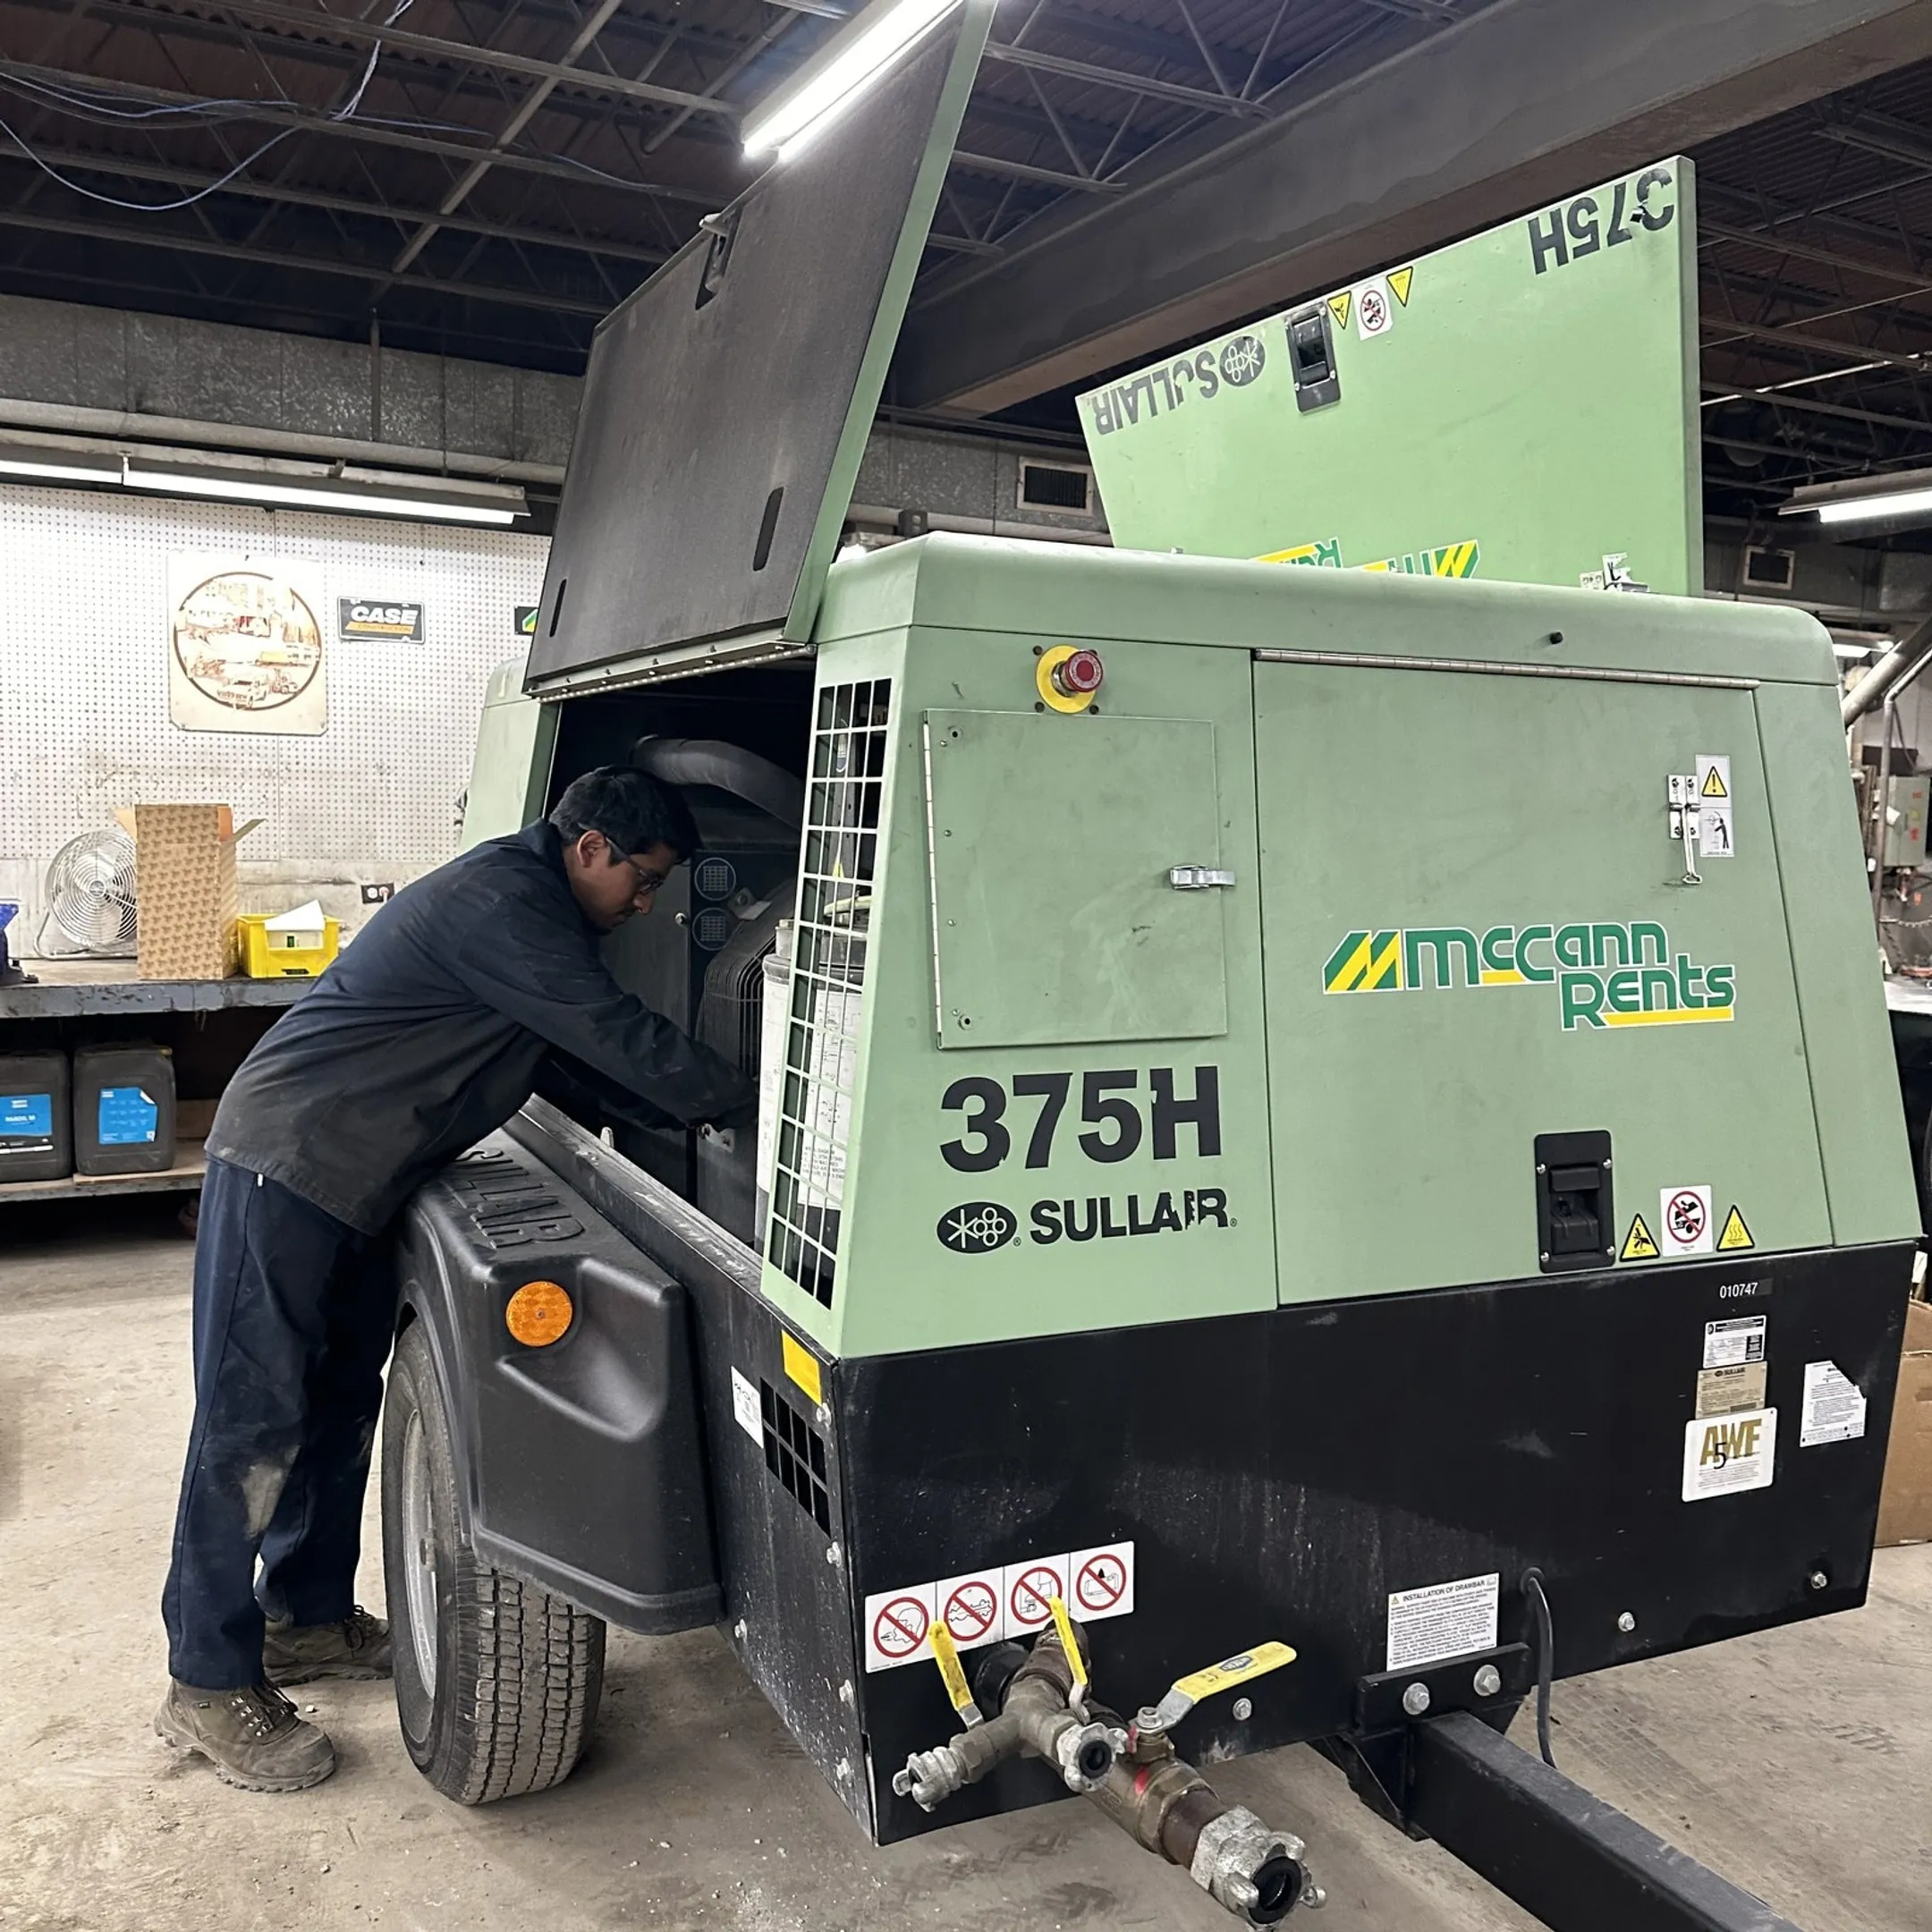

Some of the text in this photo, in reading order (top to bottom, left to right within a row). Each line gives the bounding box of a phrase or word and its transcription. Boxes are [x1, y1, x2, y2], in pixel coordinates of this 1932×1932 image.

[1528, 167, 1674, 275] 375H
[1093, 350, 1219, 436] SULLAIR
[351, 606, 419, 625] CASE
[1561, 953, 1734, 1030] Rents
[940, 1065, 1221, 1173] 375H
[1030, 1188, 1229, 1245] SULLAIR
[1719, 1283, 1758, 1300] 010747
[1713, 1442, 1727, 1470] 5
[1402, 1580, 1485, 1602] INSTALLATION OF DRAWBAR
